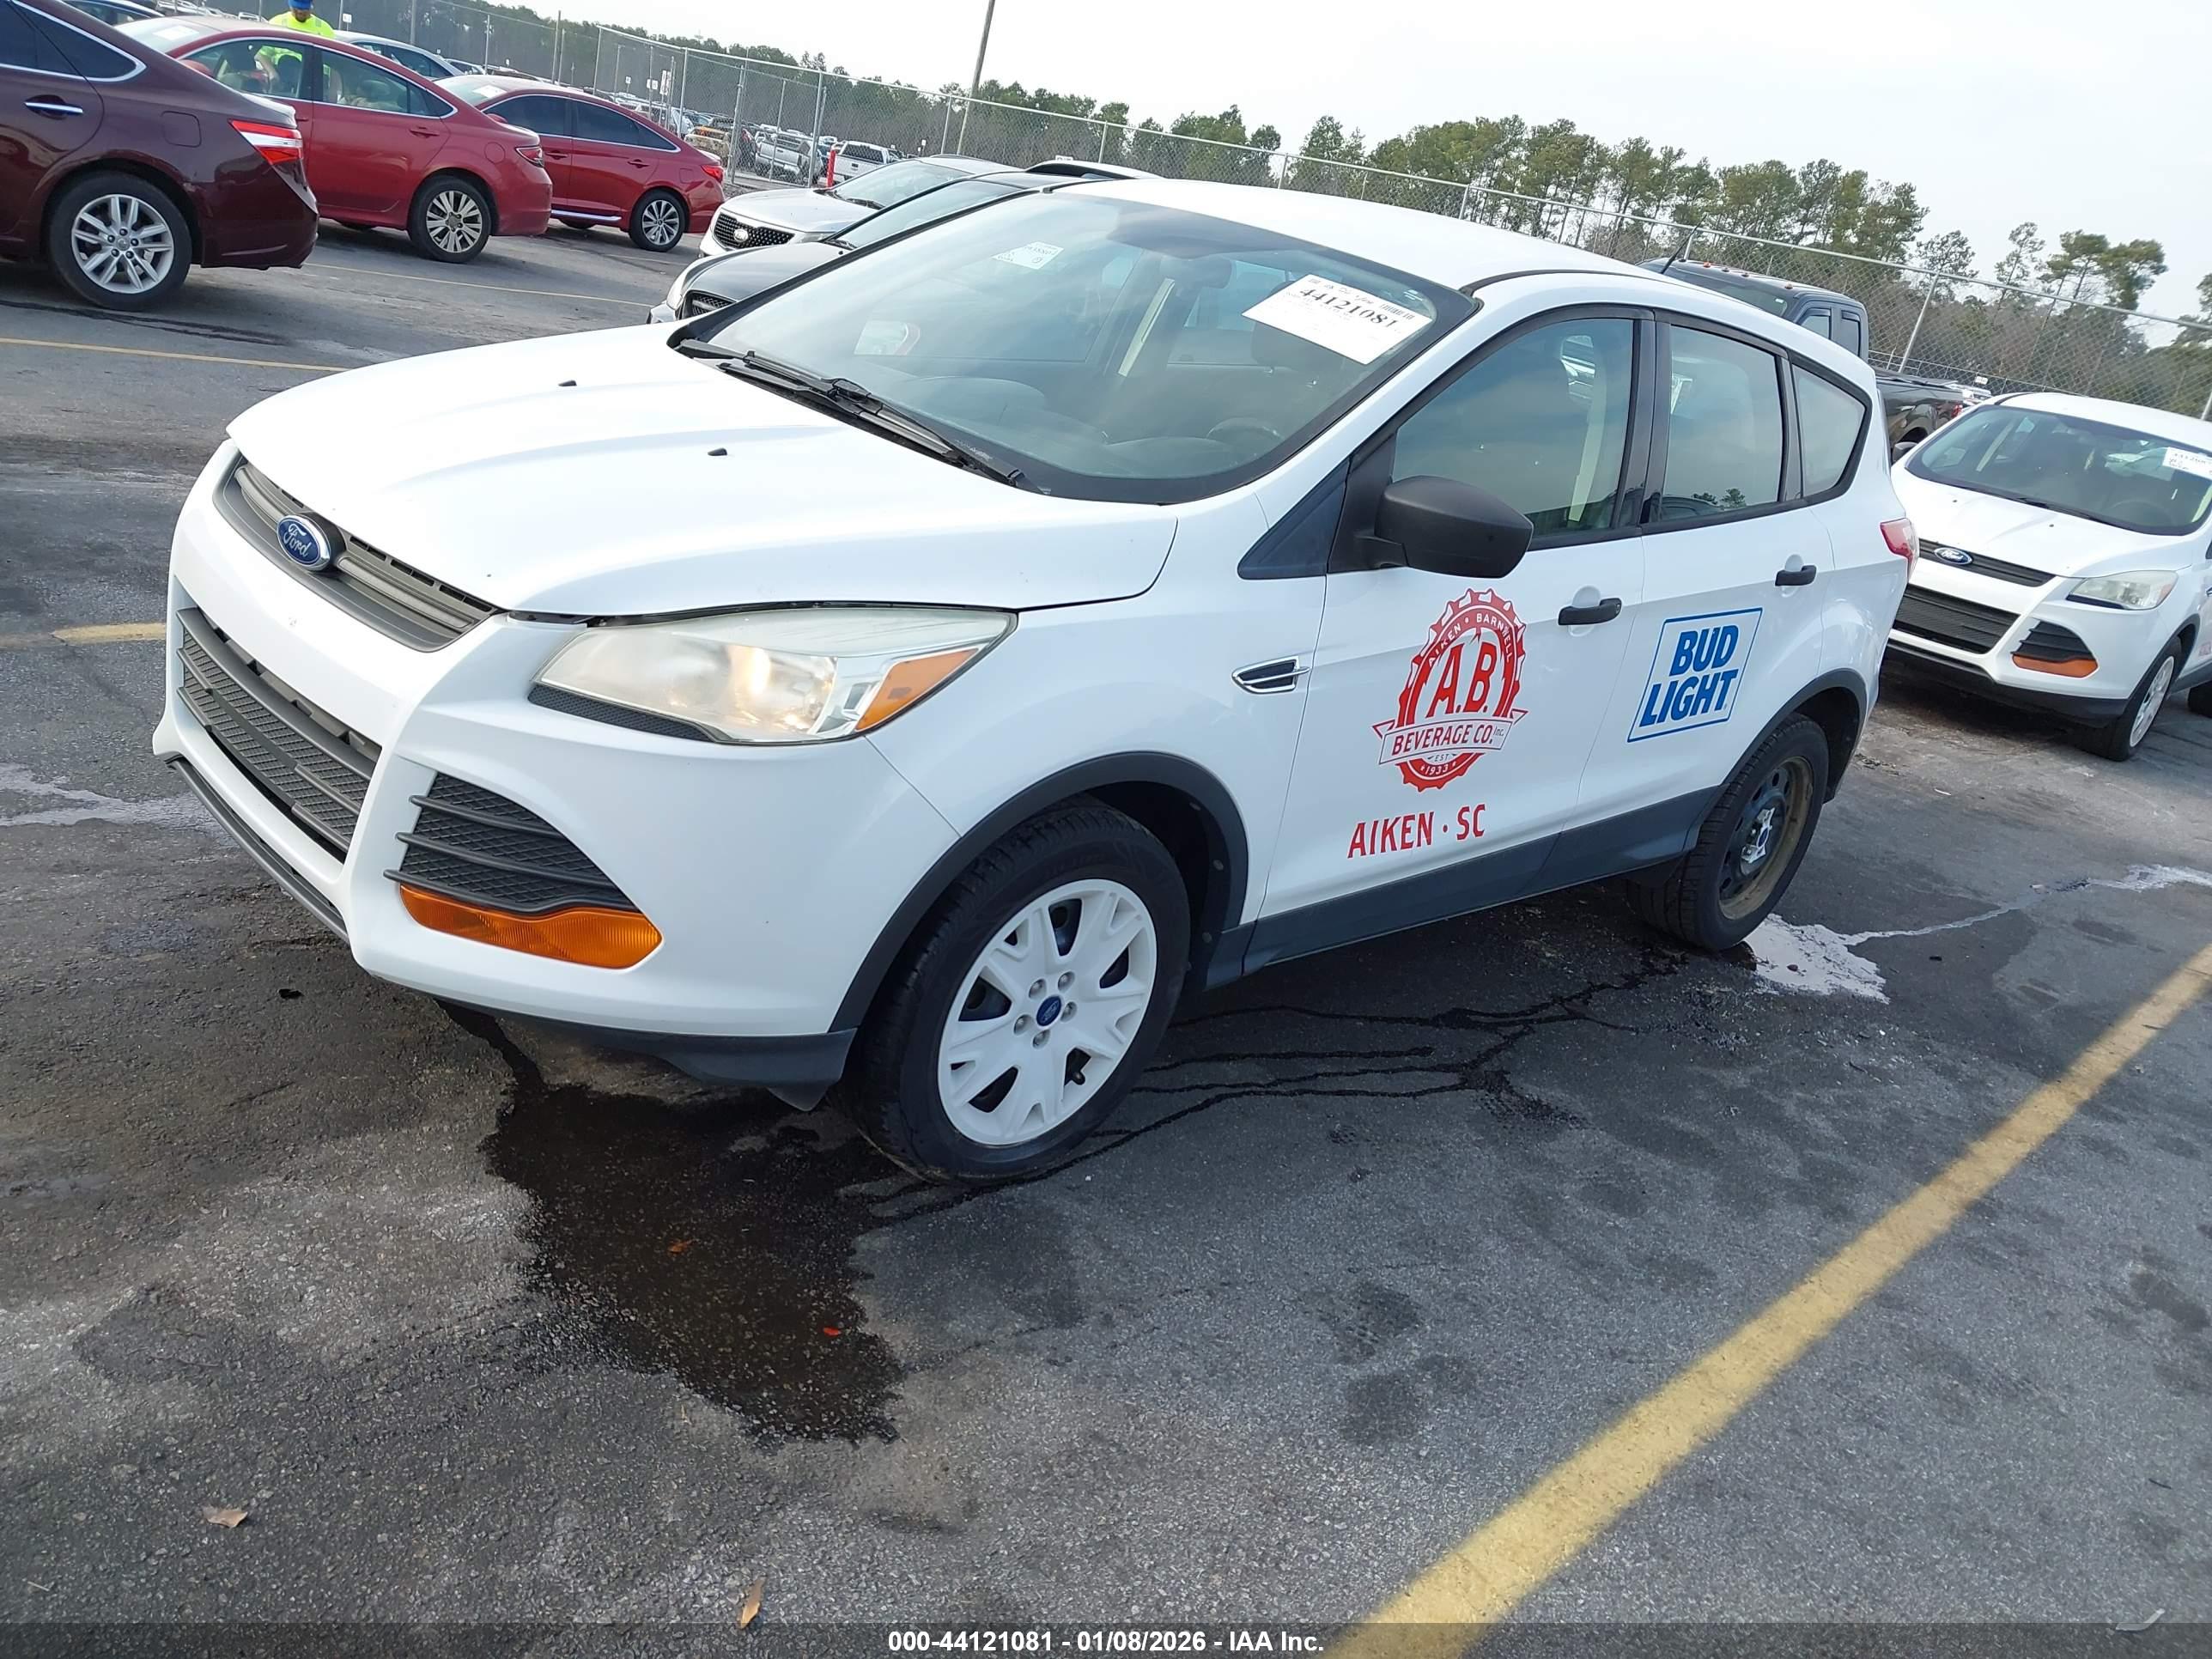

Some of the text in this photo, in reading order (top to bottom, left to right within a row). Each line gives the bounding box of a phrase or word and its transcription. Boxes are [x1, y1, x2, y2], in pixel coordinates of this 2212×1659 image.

[1299, 289, 1398, 328] 44121081
[283, 523, 312, 557] Ford
[1428, 612, 1513, 666] AIKEN BARNWELL
[1669, 625, 1739, 677] BUD
[1425, 641, 1497, 719] A.B.
[1638, 669, 1739, 727] LIGHT
[1392, 724, 1474, 756] BEVERAGE
[1474, 724, 1493, 744] CO.
[1425, 763, 1448, 776] 1933
[1347, 804, 1486, 858] AIKEN SC
